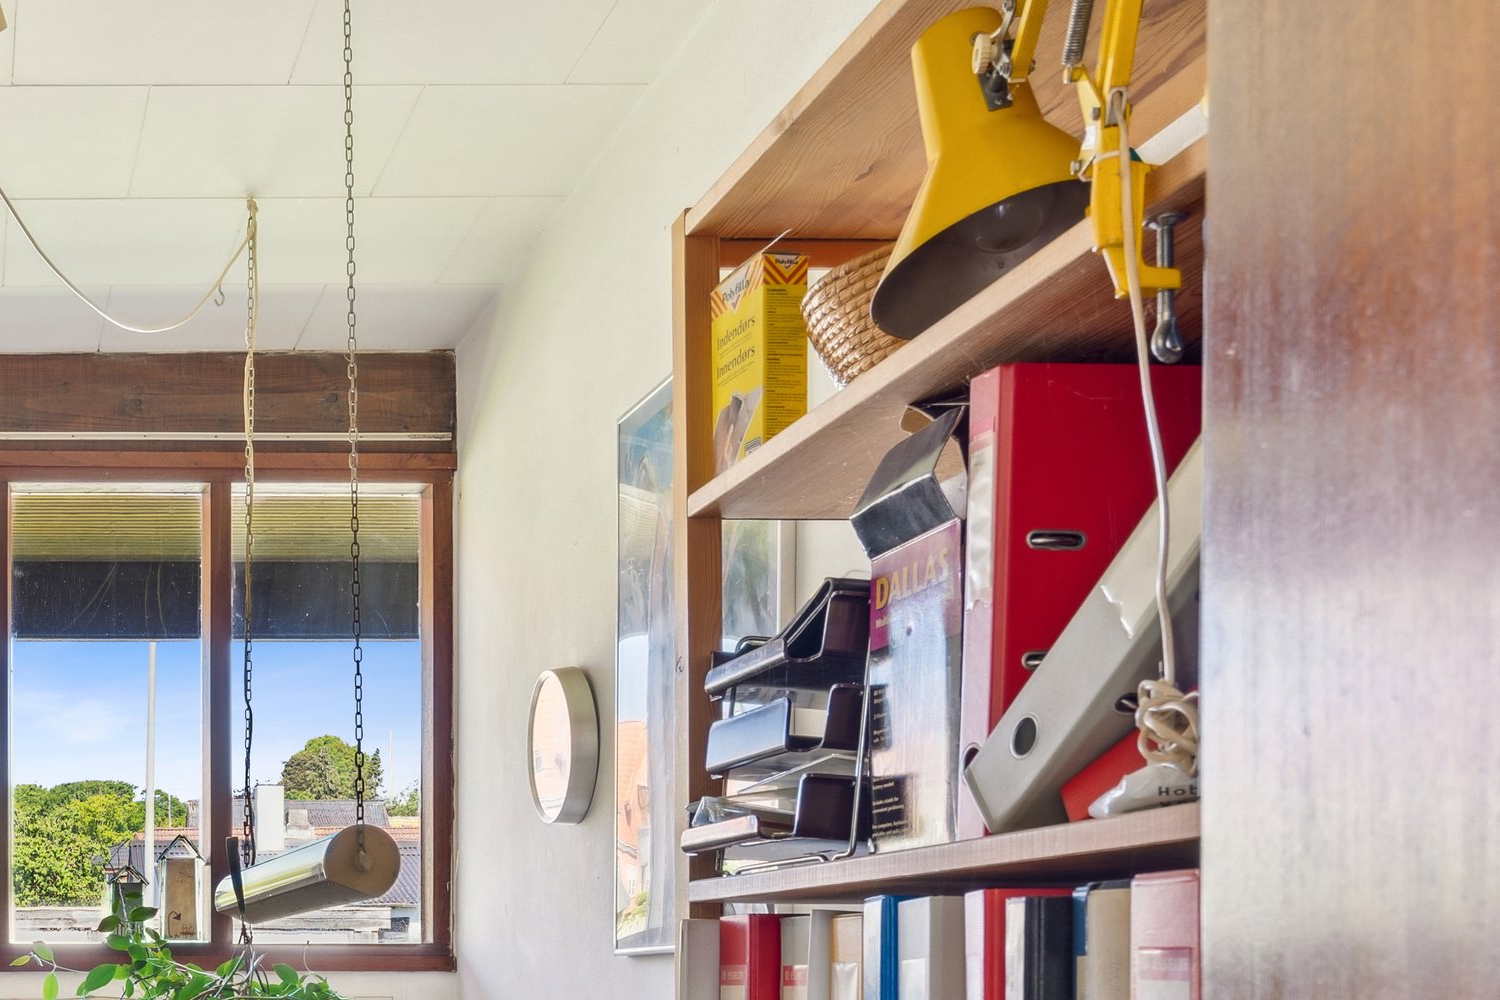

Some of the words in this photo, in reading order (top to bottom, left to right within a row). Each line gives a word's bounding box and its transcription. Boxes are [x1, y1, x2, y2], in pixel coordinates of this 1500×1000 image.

[722, 278, 750, 303] Polyfilla
[716, 314, 756, 352] Indendørs
[716, 344, 756, 381] Innendørs
[875, 546, 949, 611] DALLAS
